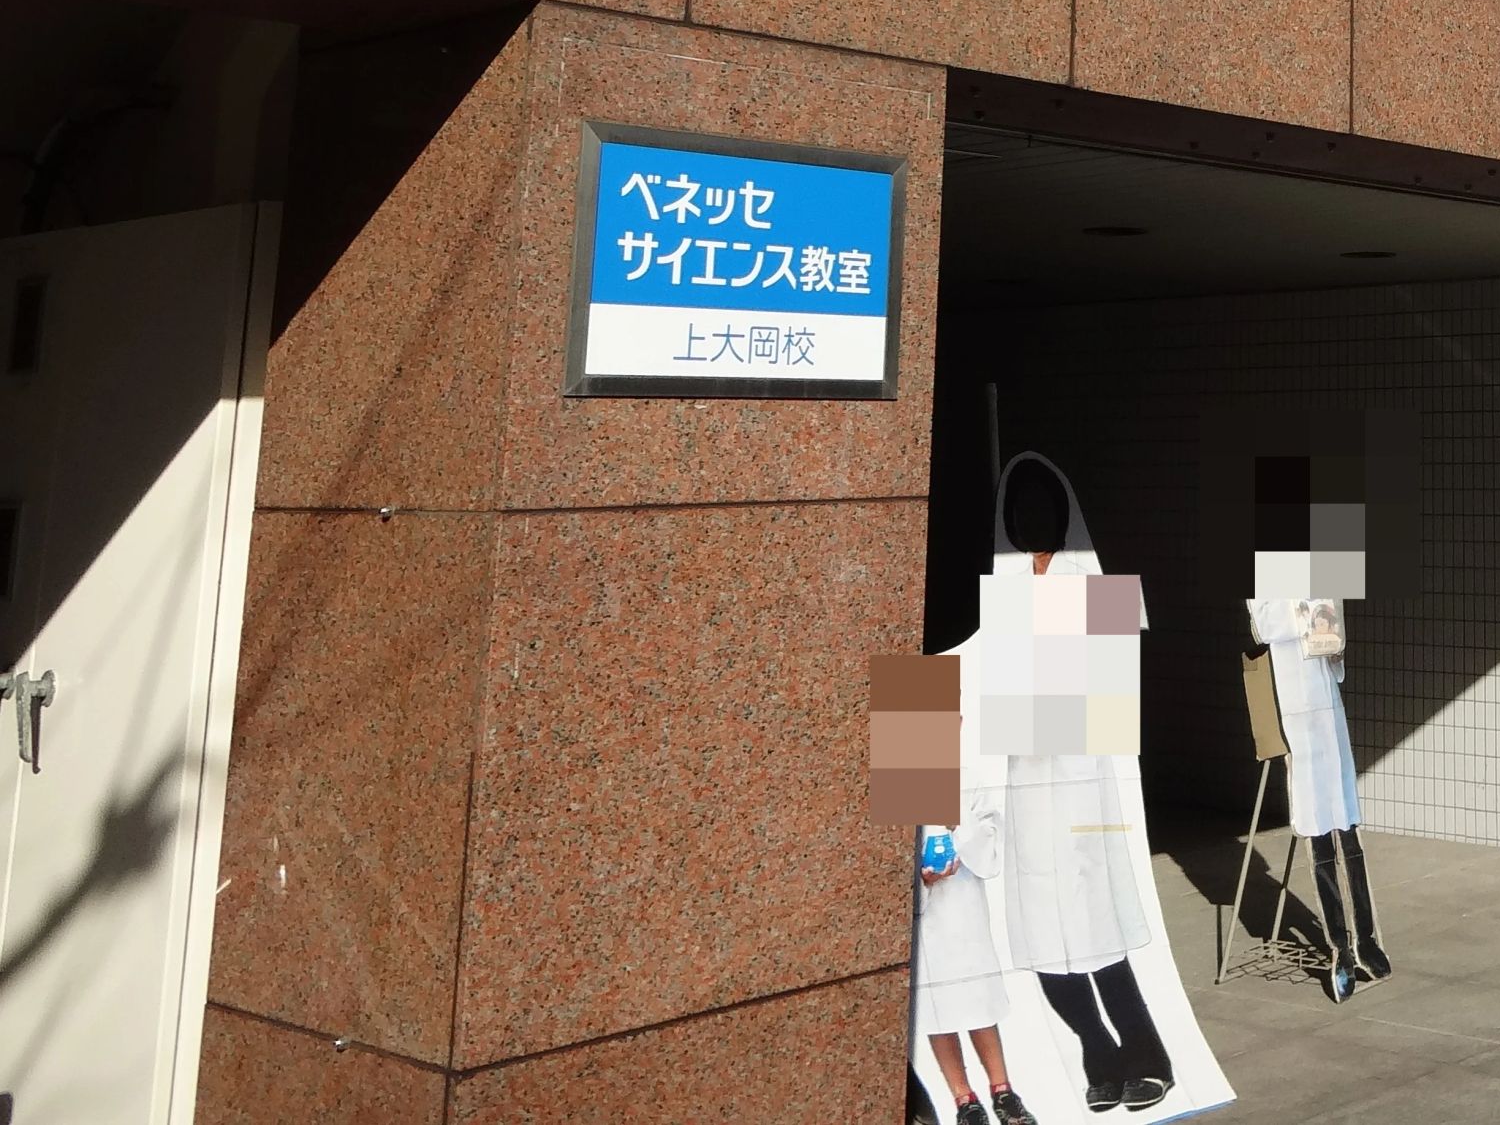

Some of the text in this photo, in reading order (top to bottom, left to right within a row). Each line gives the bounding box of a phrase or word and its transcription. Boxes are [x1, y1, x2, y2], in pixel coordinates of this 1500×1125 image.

[620, 172, 775, 230] ベネッセ
[617, 231, 873, 295] サイエンス教室
[673, 322, 816, 367] 上大岡校
